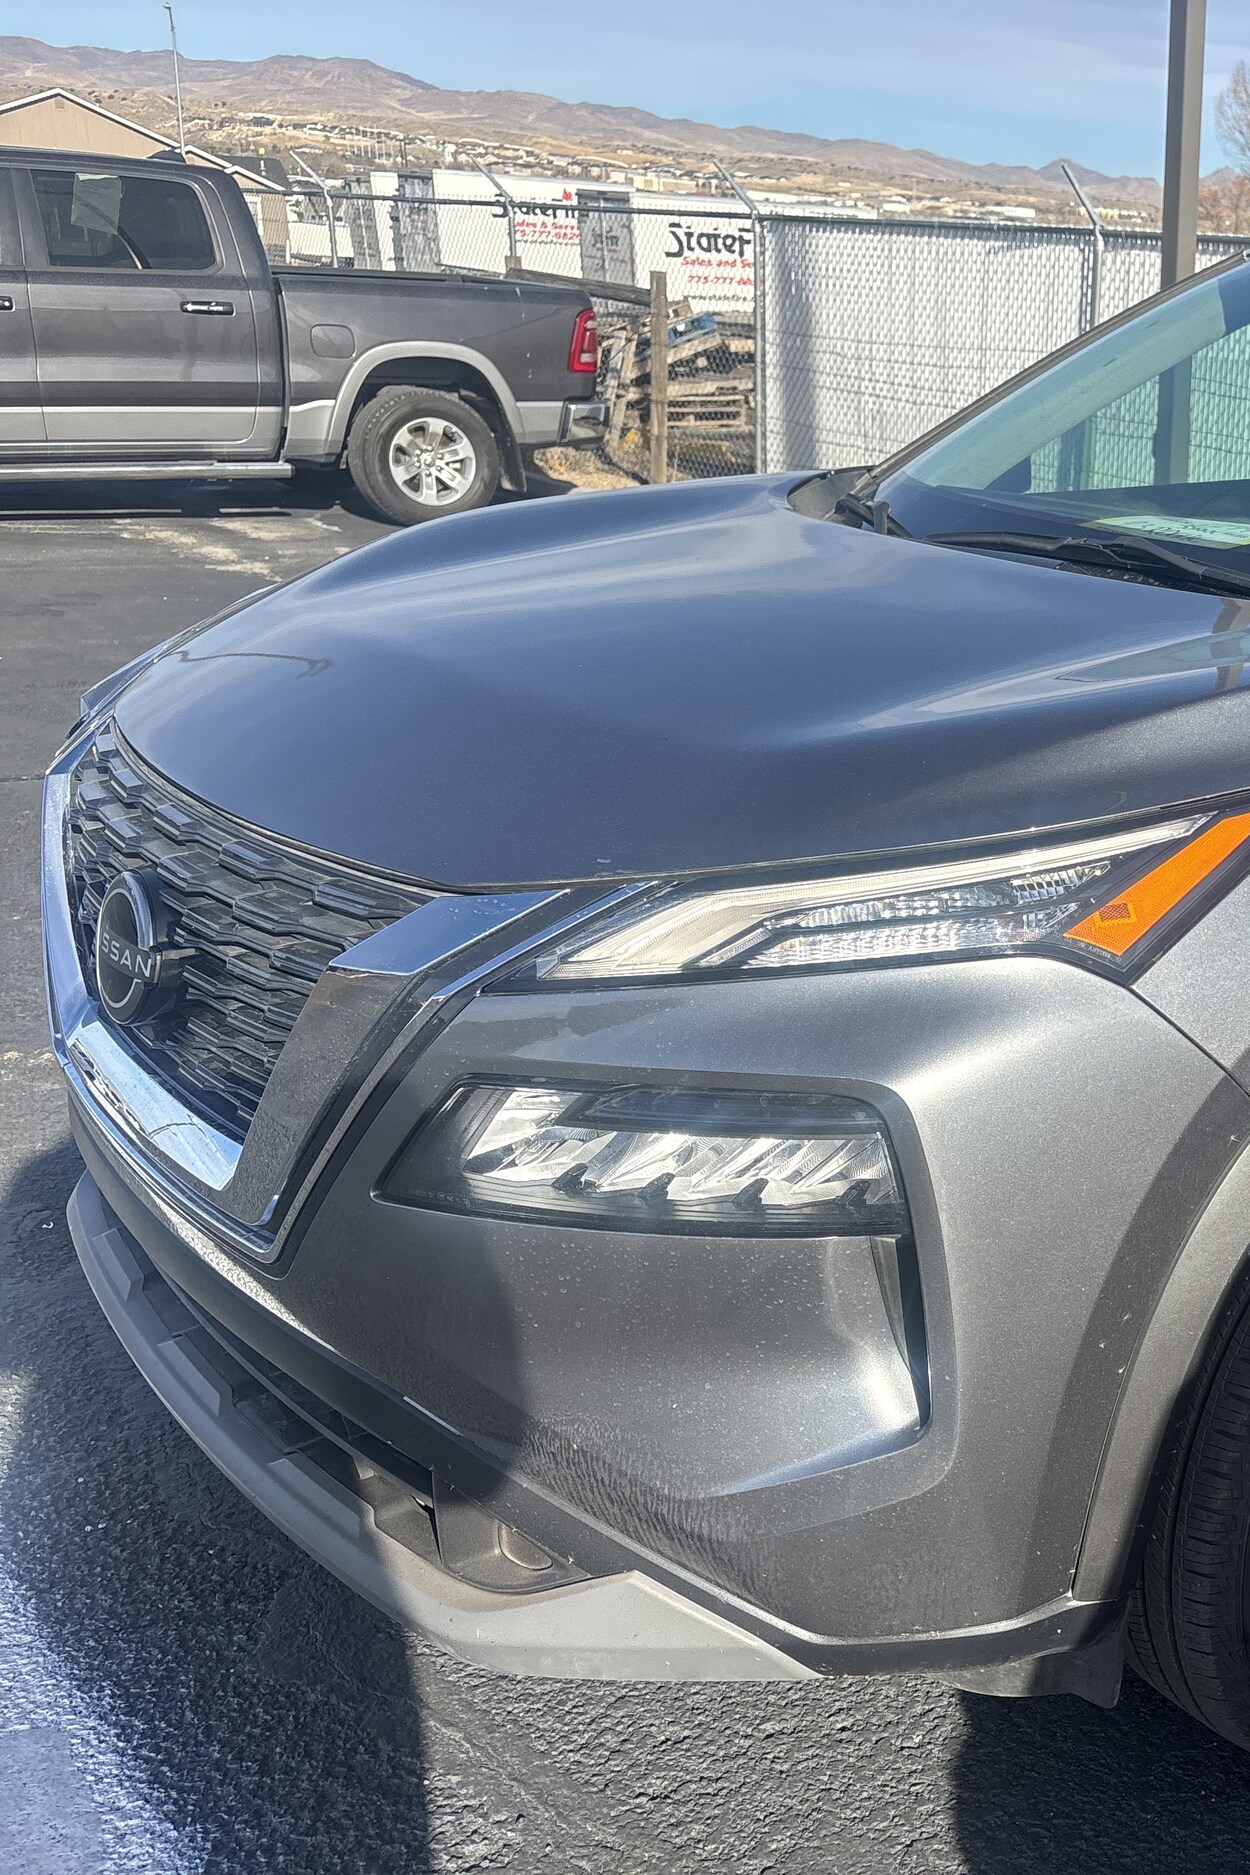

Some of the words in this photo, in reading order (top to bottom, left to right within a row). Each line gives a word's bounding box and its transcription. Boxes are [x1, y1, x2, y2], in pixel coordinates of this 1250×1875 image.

[681, 256, 713, 267] Sales
[716, 258, 736, 268] and
[102, 933, 152, 977] SSAN
